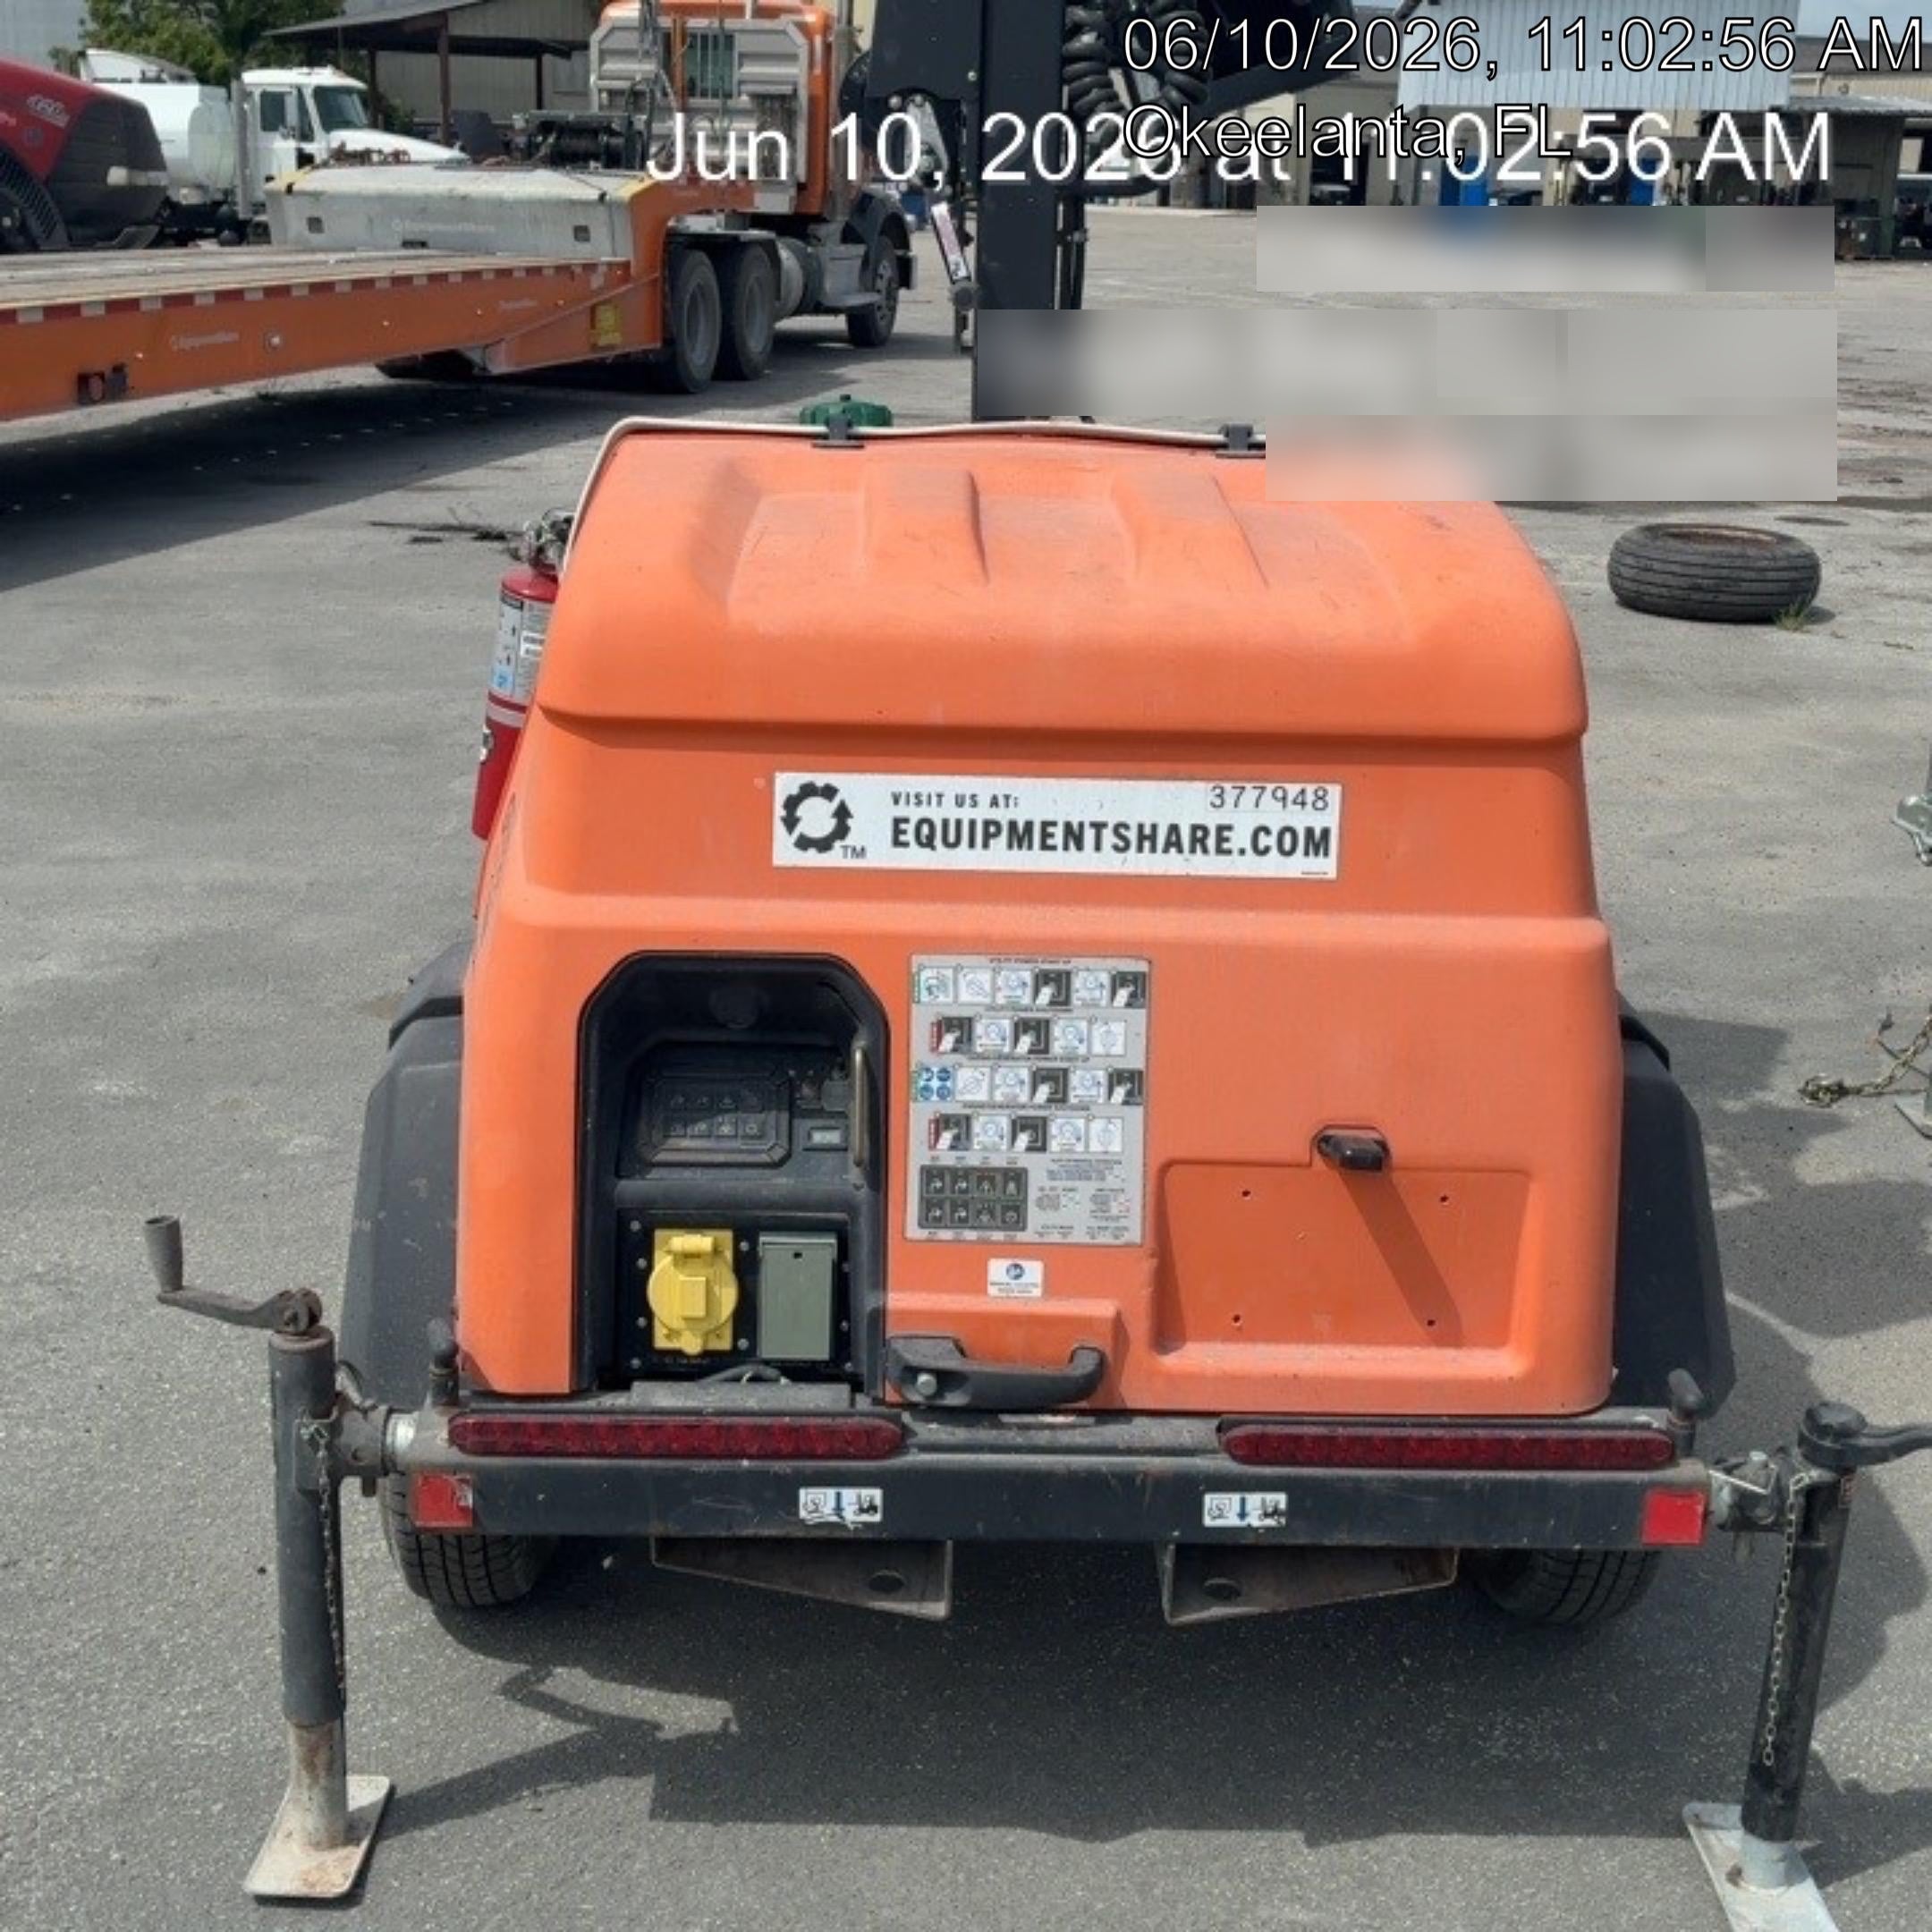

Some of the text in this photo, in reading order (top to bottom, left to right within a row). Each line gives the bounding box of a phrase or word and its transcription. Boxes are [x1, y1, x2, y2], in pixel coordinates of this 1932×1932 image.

[891, 791, 1020, 809] VISIT US AT:
[1209, 784, 1329, 812] 377948
[891, 816, 1331, 859] EQUIPMENTSHARE.COM
[841, 844, 867, 860] TM
